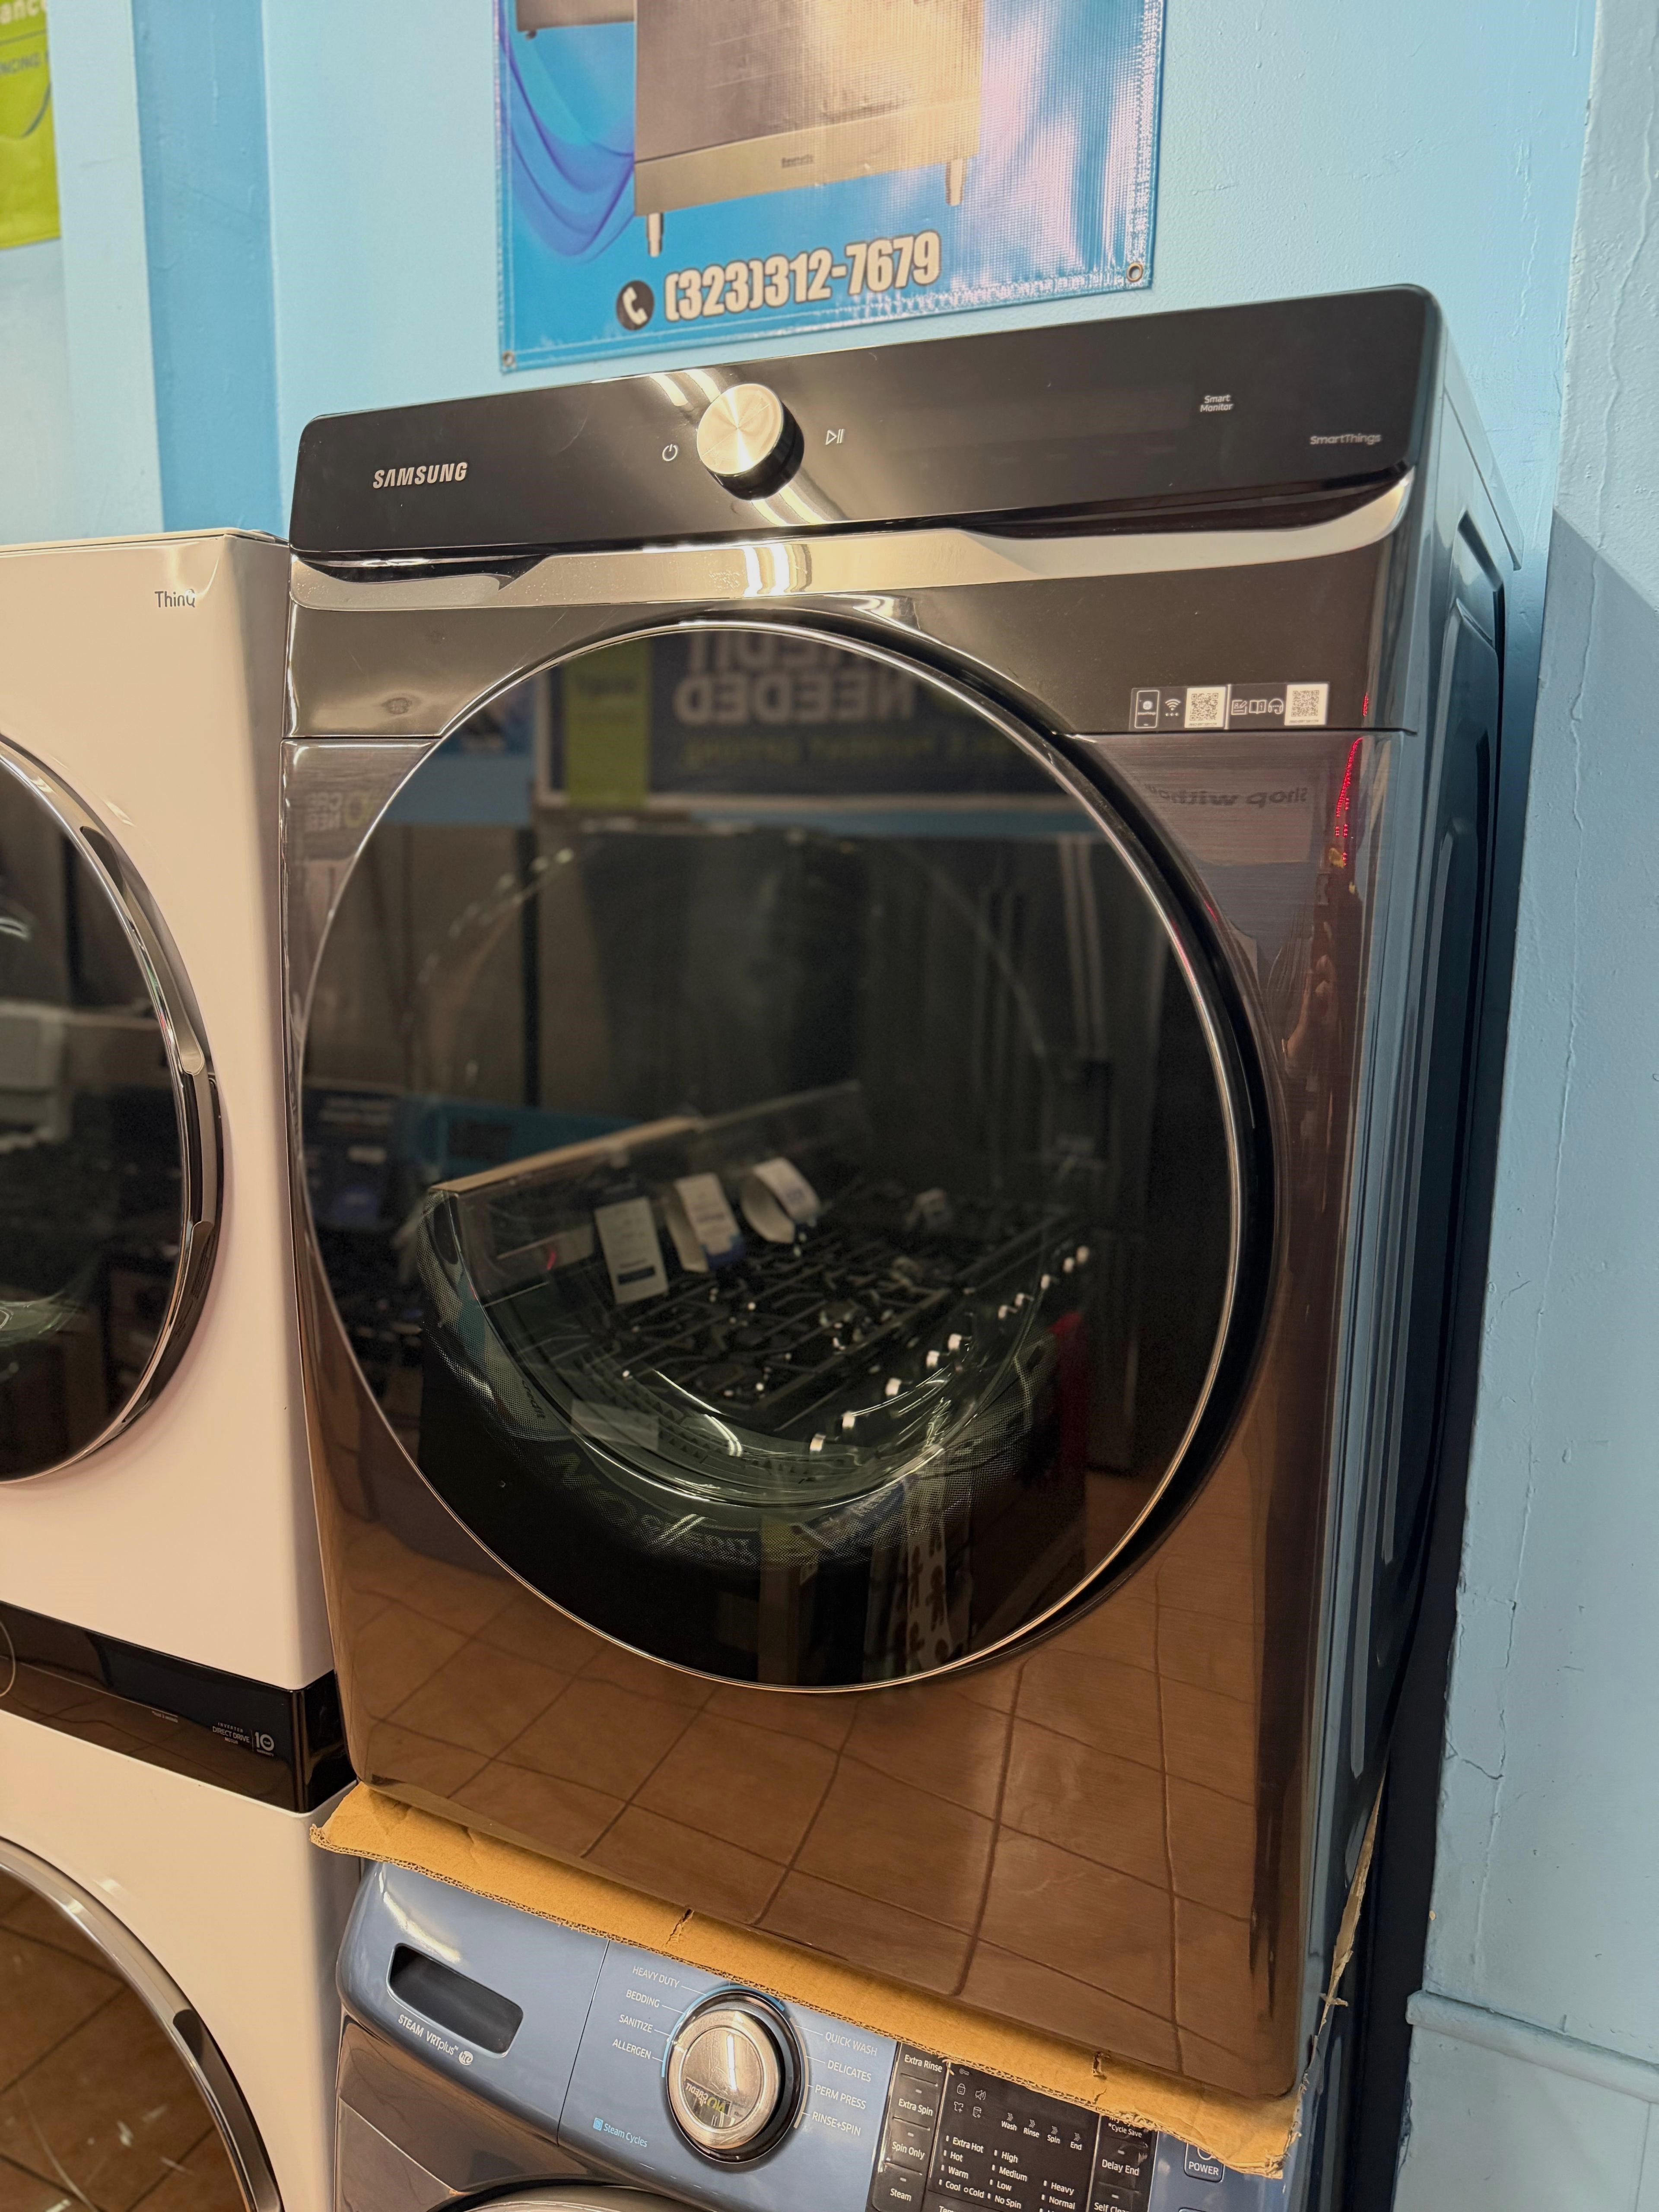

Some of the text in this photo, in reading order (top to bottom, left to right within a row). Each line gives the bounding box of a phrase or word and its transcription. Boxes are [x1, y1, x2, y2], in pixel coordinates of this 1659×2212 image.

[664, 232, 941, 322] (323)312-7679
[1205, 394, 1231, 404] Smart
[1200, 403, 1233, 412] Monitor
[1310, 433, 1381, 445] SmartThings
[373, 461, 468, 489] SAMSUNG
[155, 588, 195, 608] ThinQ
[212, 1726, 232, 1738] DIRECT
[232, 1732, 250, 1743] DRIVE
[632, 1966, 680, 1988] HEAVY DUTY
[626, 1990, 661, 2008] BEDDING
[398, 2014, 424, 2037] STEAM
[619, 2014, 653, 2033] SANITIZE
[612, 2039, 652, 2059] ALLERGEN
[825, 2031, 877, 2056] QUICK WASH
[828, 2059, 871, 2082] DELICATES
[905, 2054, 943, 2073] Extra Rinse
[815, 2084, 867, 2110] PERM PRESS
[898, 2098, 934, 2116] Extra Spin
[812, 2111, 861, 2136] RINSE+SPIN
[1001, 2120, 1017, 2131] Wash
[604, 2123, 648, 2148] Steam Cycles
[1023, 2127, 1040, 2138] Rinse
[1047, 2134, 1061, 2144] Spin
[1128, 2129, 1142, 2138] Save
[892, 2141, 925, 2160] Spin Only
[953, 2136, 984, 2153] Extra Hot
[1070, 2141, 1082, 2151] End
[950, 2151, 963, 2162] Hot
[1001, 2151, 1018, 2163] High
[948, 2165, 969, 2179] Warm
[999, 2166, 1027, 2182] Medium
[1102, 2159, 1139, 2176] Delay End
[1189, 2161, 1219, 2176] POWER
[945, 2180, 961, 2192] Cool
[997, 2181, 1012, 2191] Low
[1051, 2182, 1074, 2196] Heavy
[890, 2188, 912, 2202] Steam
[995, 2195, 1022, 2209] No Spin
[1049, 2195, 1075, 2210] Normal
[1093, 2202, 1109, 2212] Self
